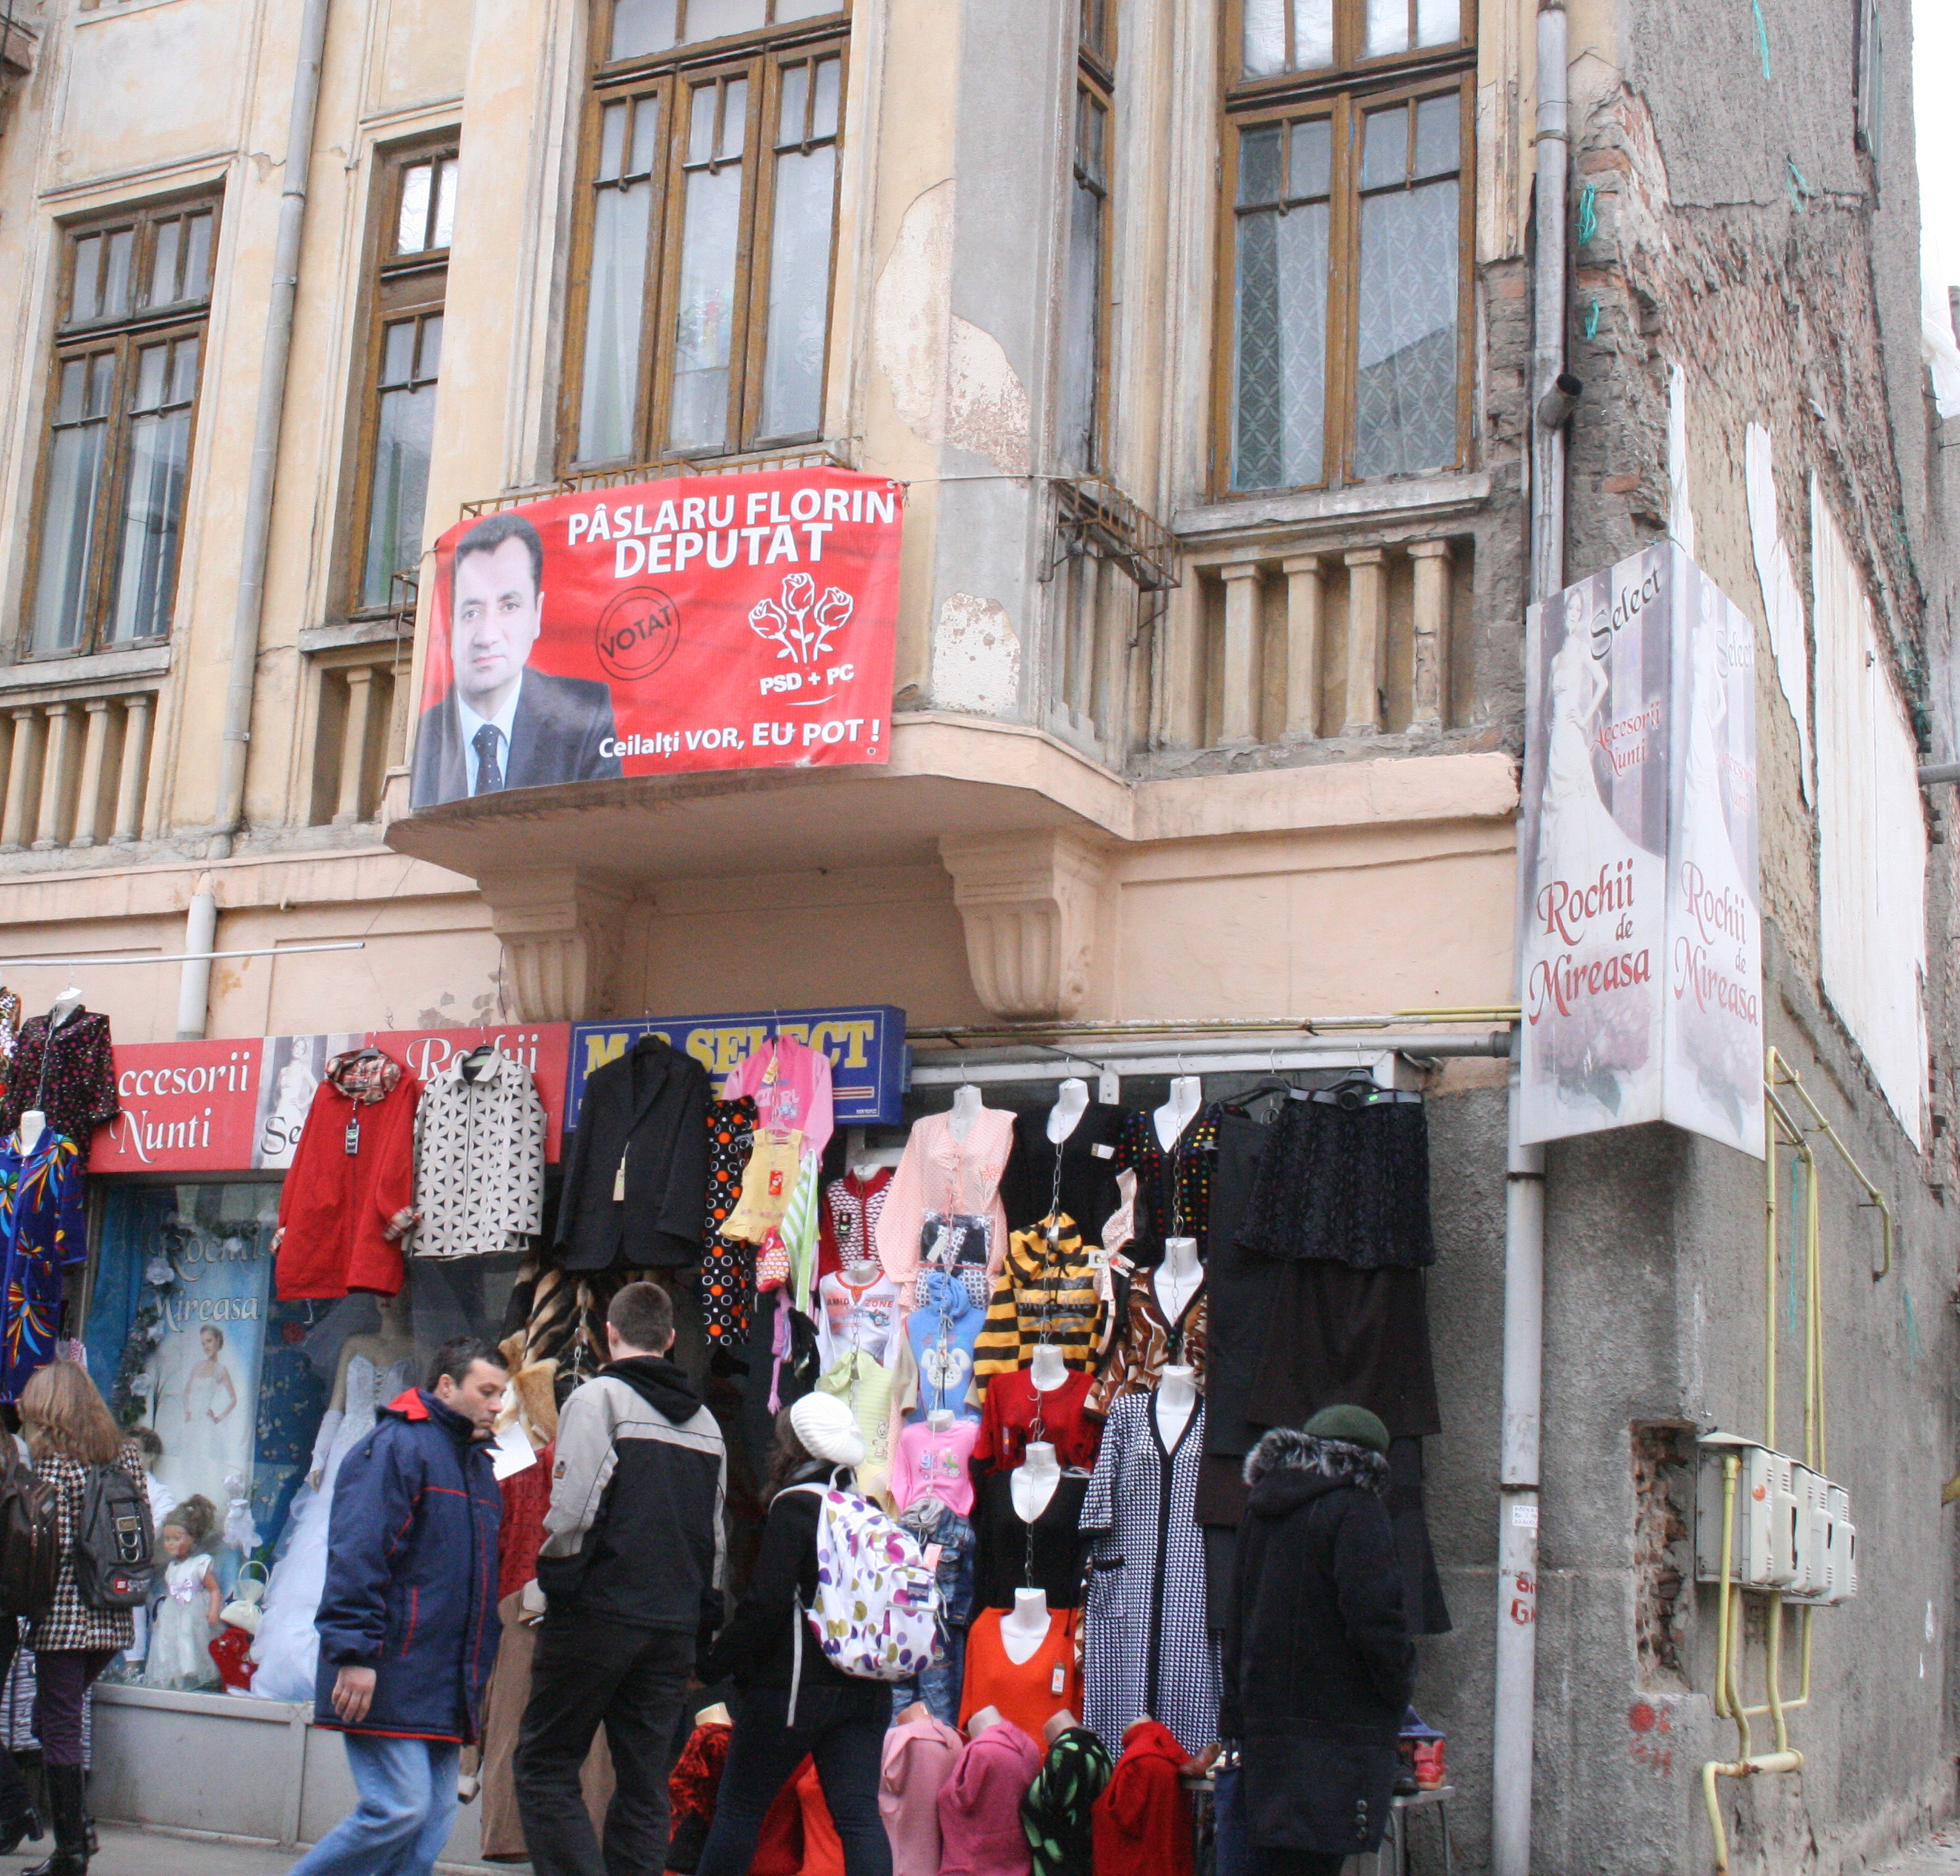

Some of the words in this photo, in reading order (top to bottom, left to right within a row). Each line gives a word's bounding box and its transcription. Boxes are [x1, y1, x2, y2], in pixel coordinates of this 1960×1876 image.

[567, 493, 736, 546] PÂSLARU
[747, 488, 896, 525] FLORIN
[615, 522, 834, 579] DEPUTAT
[601, 603, 674, 660] VOTAT
[1590, 566, 1662, 661] Select
[759, 672, 801, 695] PSD
[807, 673, 821, 685] +
[827, 663, 855, 682] PC
[599, 728, 679, 759] Ceilalți
[687, 727, 745, 752] VOR,
[753, 722, 795, 747] EU
[802, 719, 865, 747] POT
[1590, 701, 1662, 752] Accesorii
[1602, 738, 1647, 777] Nunti
[1536, 858, 1635, 946] Rochii
[1616, 912, 1633, 941] de
[1681, 860, 1747, 946] Rochii
[1528, 948, 1651, 1026] Mireasa
[1673, 936, 1759, 1027] Mireasa
[1735, 948, 1747, 974] de
[118, 1051, 251, 1097] ccesorii
[110, 1107, 213, 1164] Nunti
